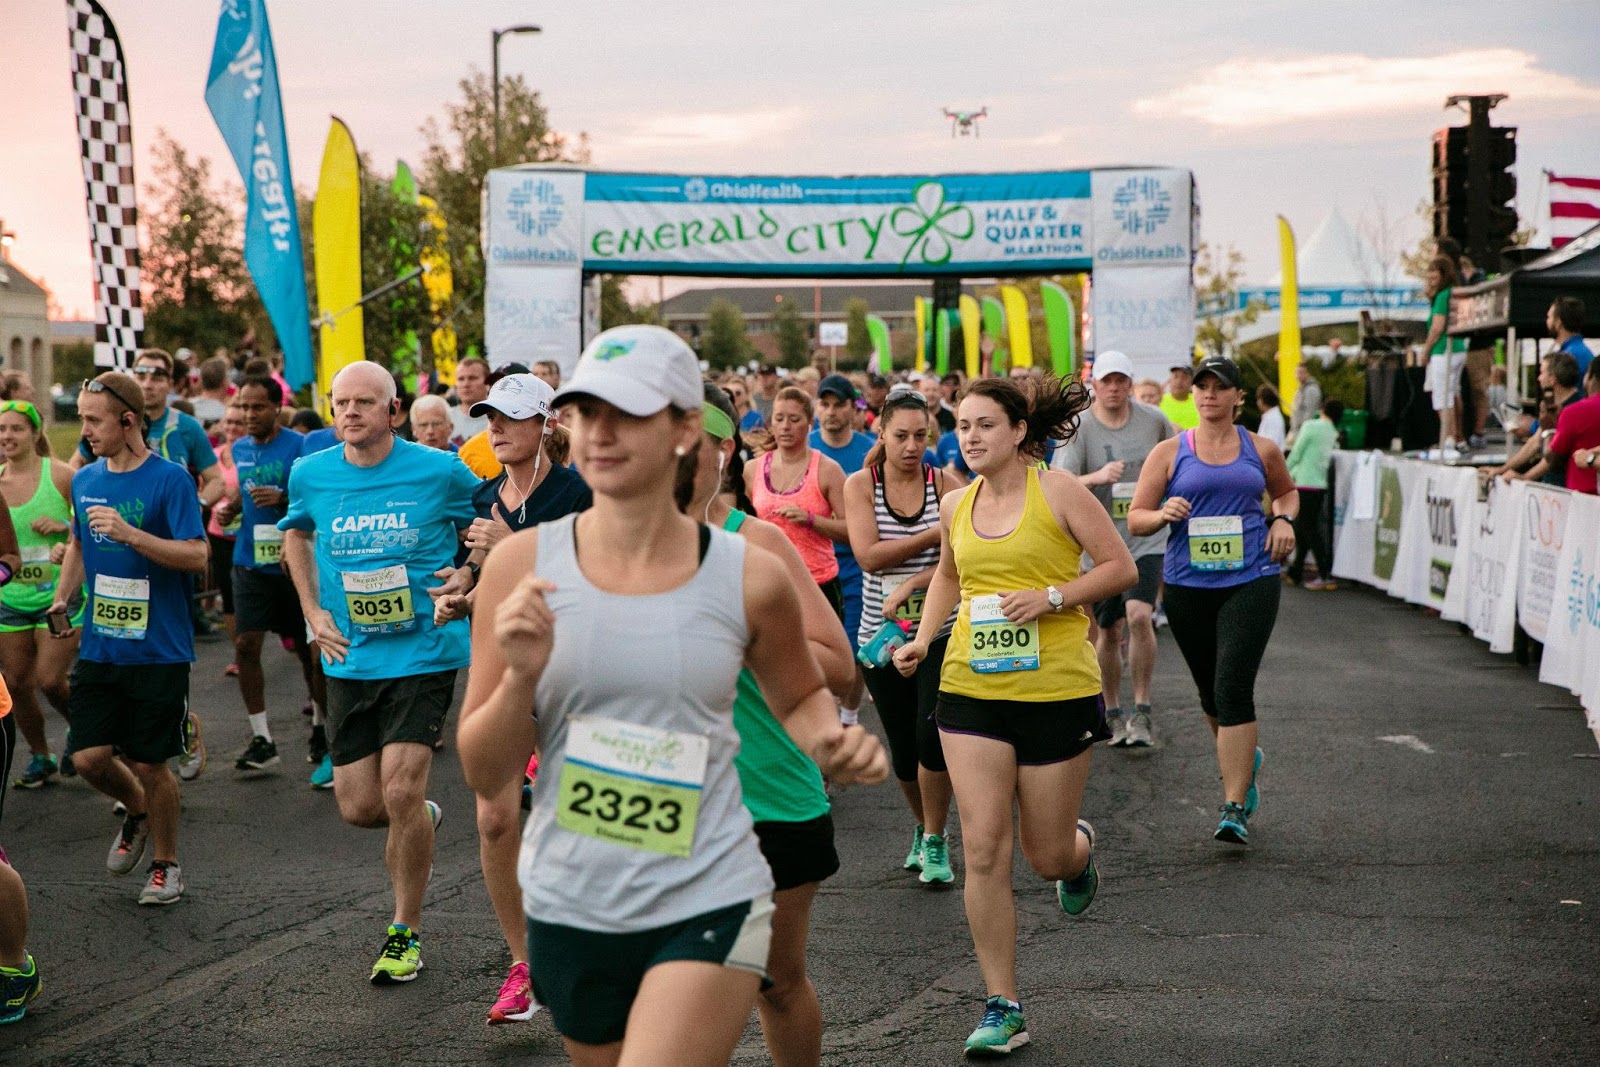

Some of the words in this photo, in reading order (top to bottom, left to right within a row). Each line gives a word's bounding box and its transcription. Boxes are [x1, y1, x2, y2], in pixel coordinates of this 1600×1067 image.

[710, 181, 803, 199] OhioHealth
[986, 207, 1036, 221] HALF
[1042, 205, 1057, 221] &
[591, 208, 778, 256] EMERALD
[786, 213, 884, 260] CITY
[985, 223, 1083, 244] QUARTER
[1003, 243, 1083, 256] MARATHON
[1097, 245, 1185, 260] OhioHealth
[331, 512, 409, 533] CAPITAL
[1200, 541, 1231, 555] 401
[97, 602, 142, 621] 2585
[352, 596, 404, 616] 3031
[973, 628, 1030, 650] 3490
[568, 780, 683, 835] 2323
